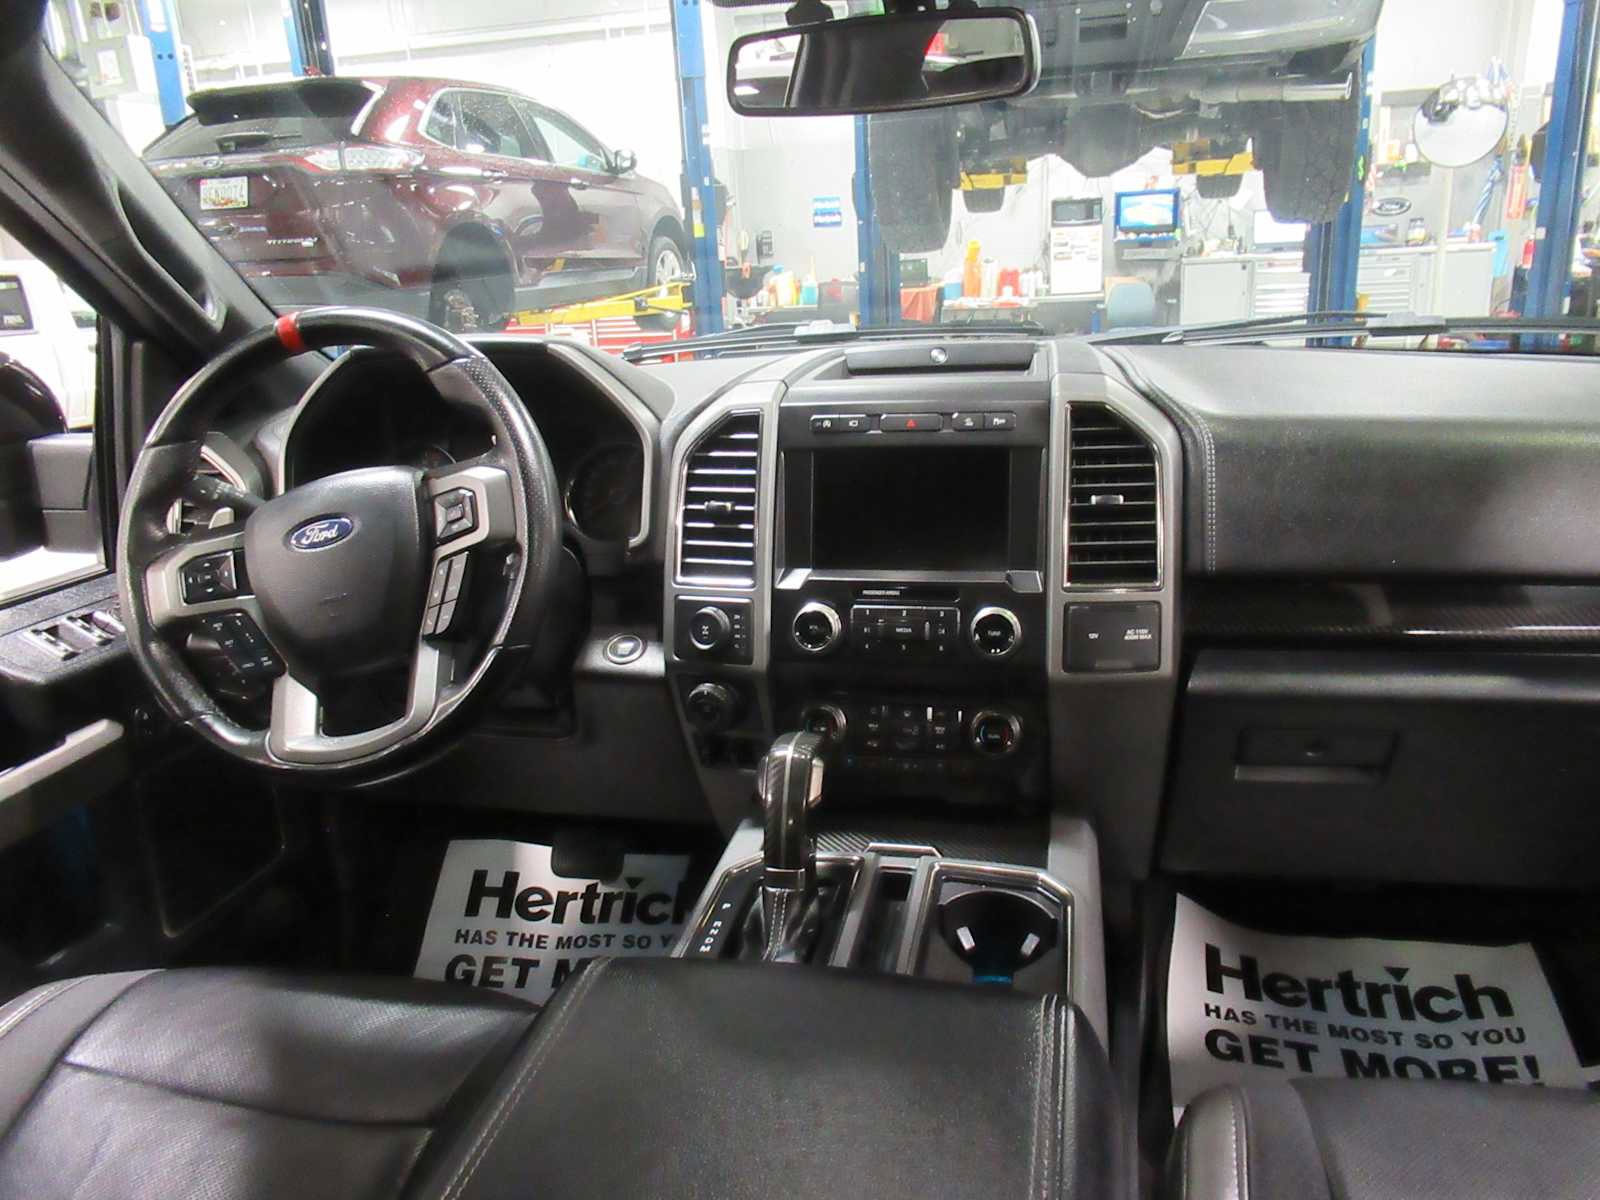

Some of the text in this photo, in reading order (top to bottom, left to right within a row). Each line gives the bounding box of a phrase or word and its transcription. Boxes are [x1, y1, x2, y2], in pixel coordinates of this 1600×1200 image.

[300, 522, 339, 545] Ford
[454, 929, 497, 946] HAS
[506, 931, 548, 950] THE
[555, 934, 616, 951] MOST
[622, 933, 651, 949] SO
[445, 954, 540, 989] GET
[1205, 943, 1515, 1023] Hertrich
[1205, 1003, 1526, 1050] HAS THE MOST SO YOU
[1205, 1029, 1320, 1073] GET
